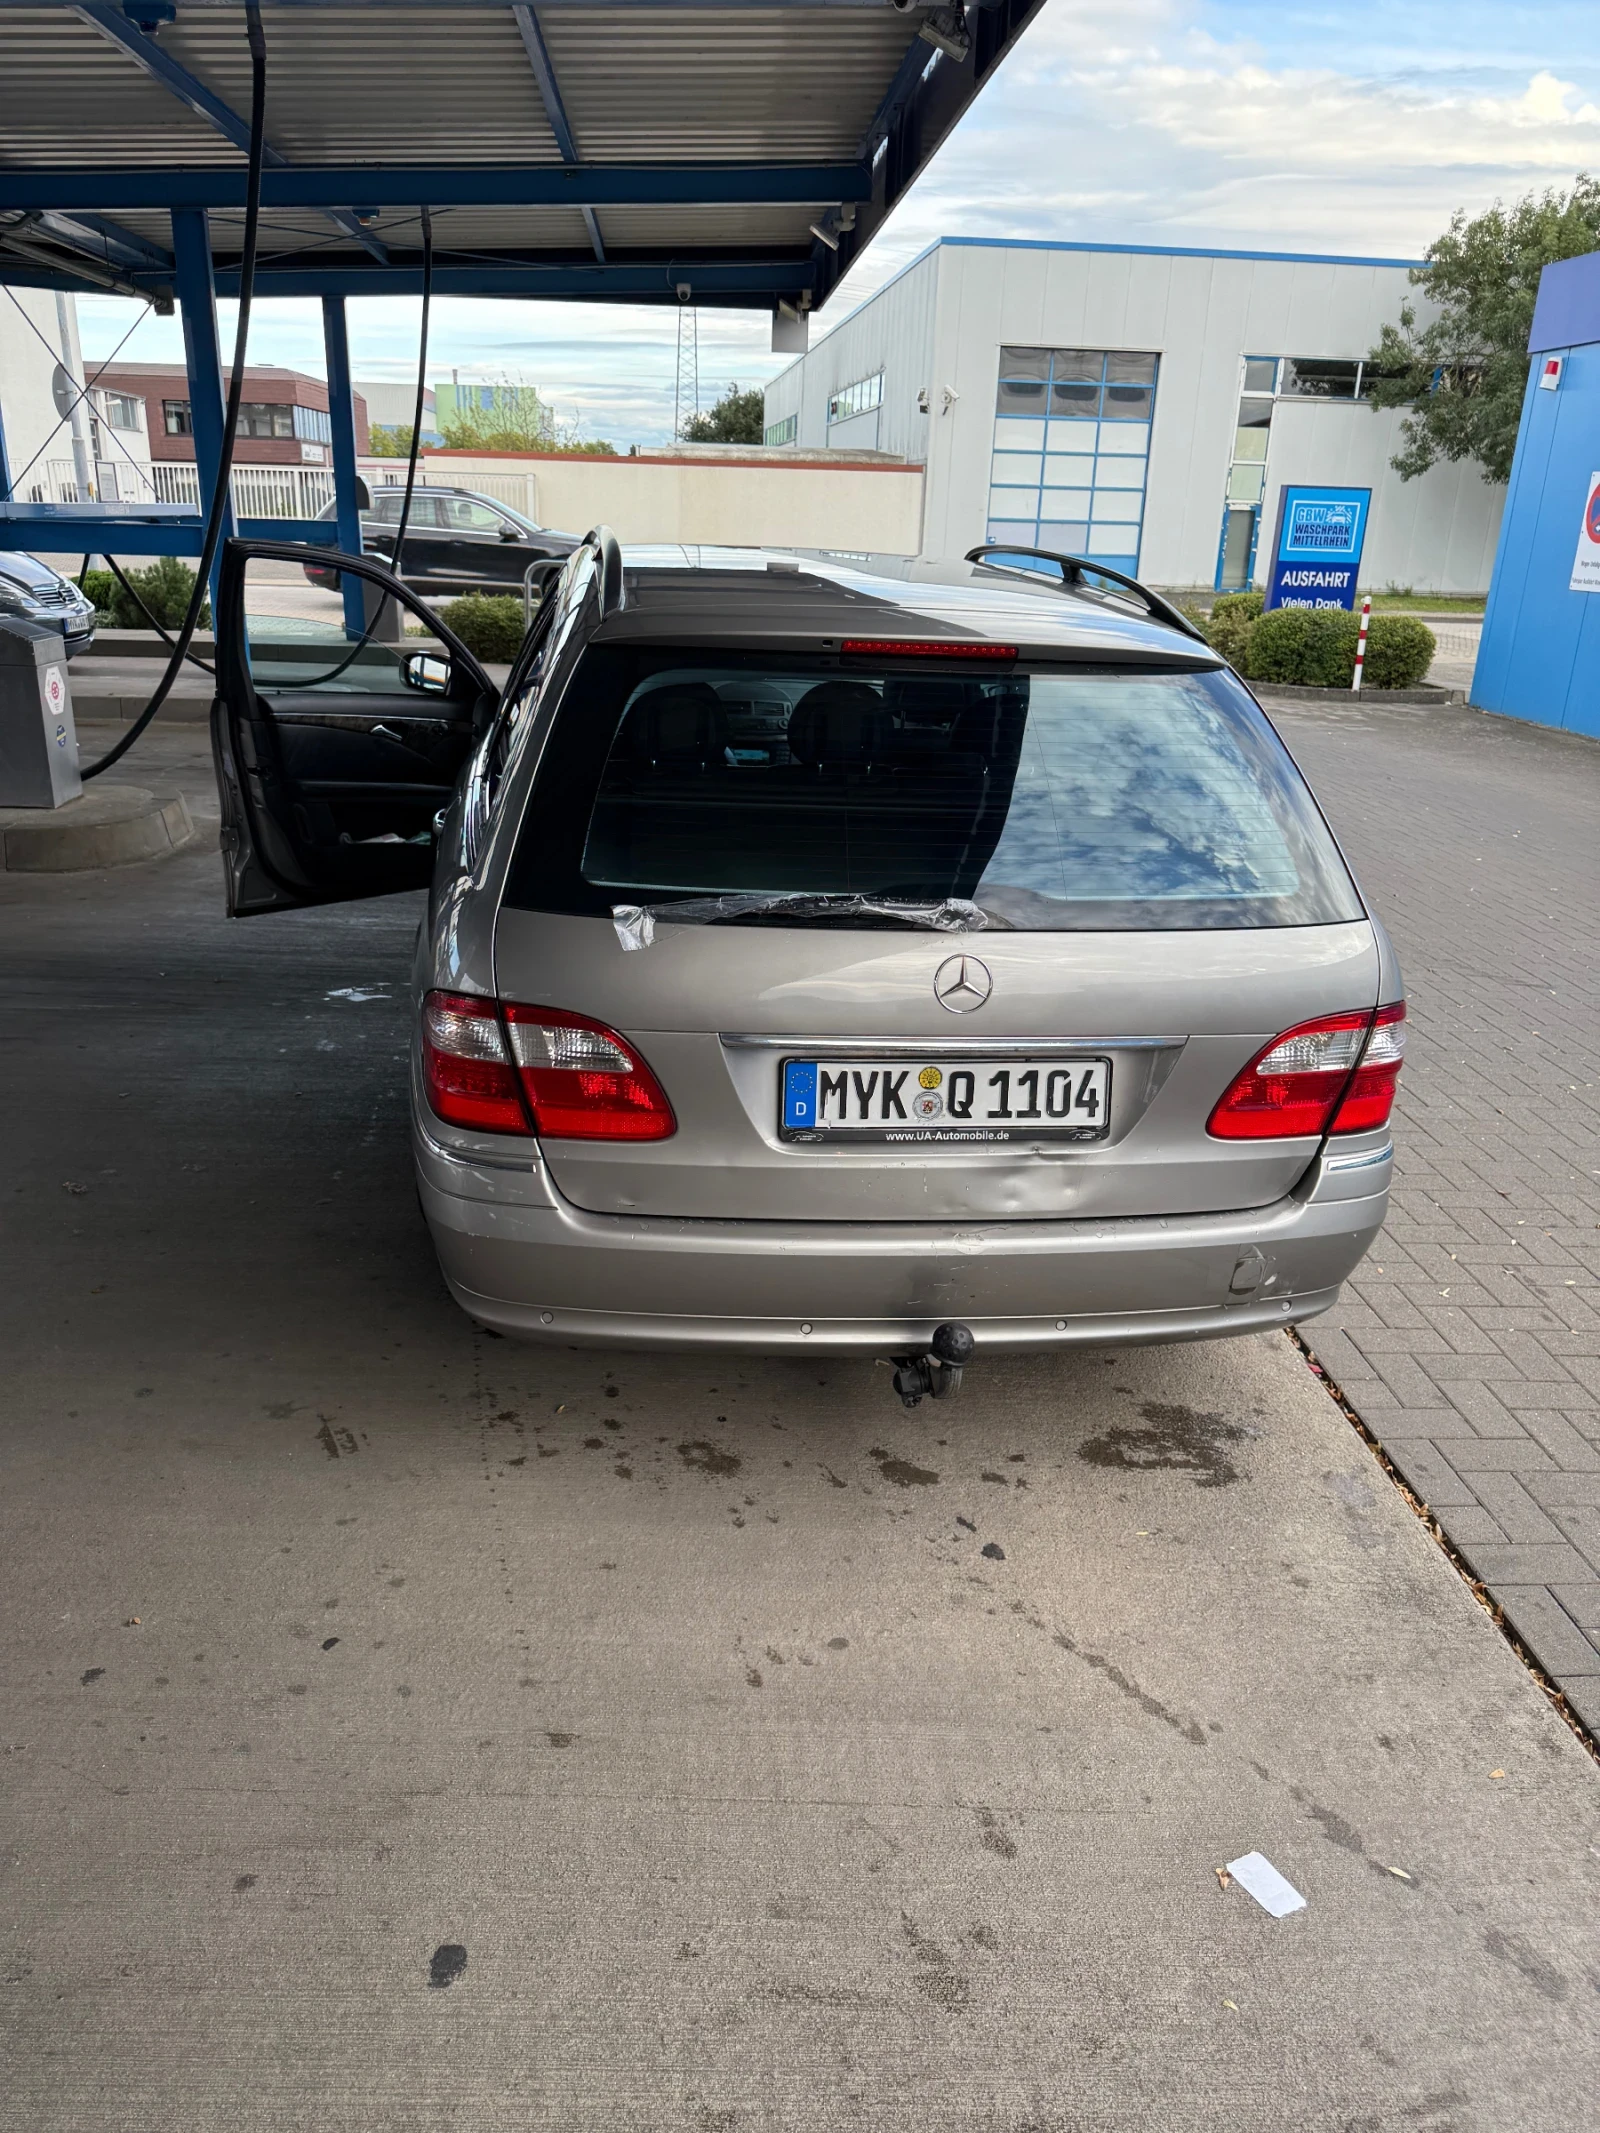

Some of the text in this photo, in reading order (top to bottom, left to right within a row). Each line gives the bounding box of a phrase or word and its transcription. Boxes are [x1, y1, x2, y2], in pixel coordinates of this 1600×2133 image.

[1297, 508, 1326, 523] GBW
[1295, 524, 1351, 536] WASCHPARK
[1293, 535, 1350, 547] MITTELRHEIN
[1281, 570, 1351, 588] AUSFAHRT
[1281, 597, 1343, 610] Vielen Dank
[795, 1069, 1101, 1121] D MYK Q 1104
[885, 1130, 1010, 1142] www.UA-Automobile.de
